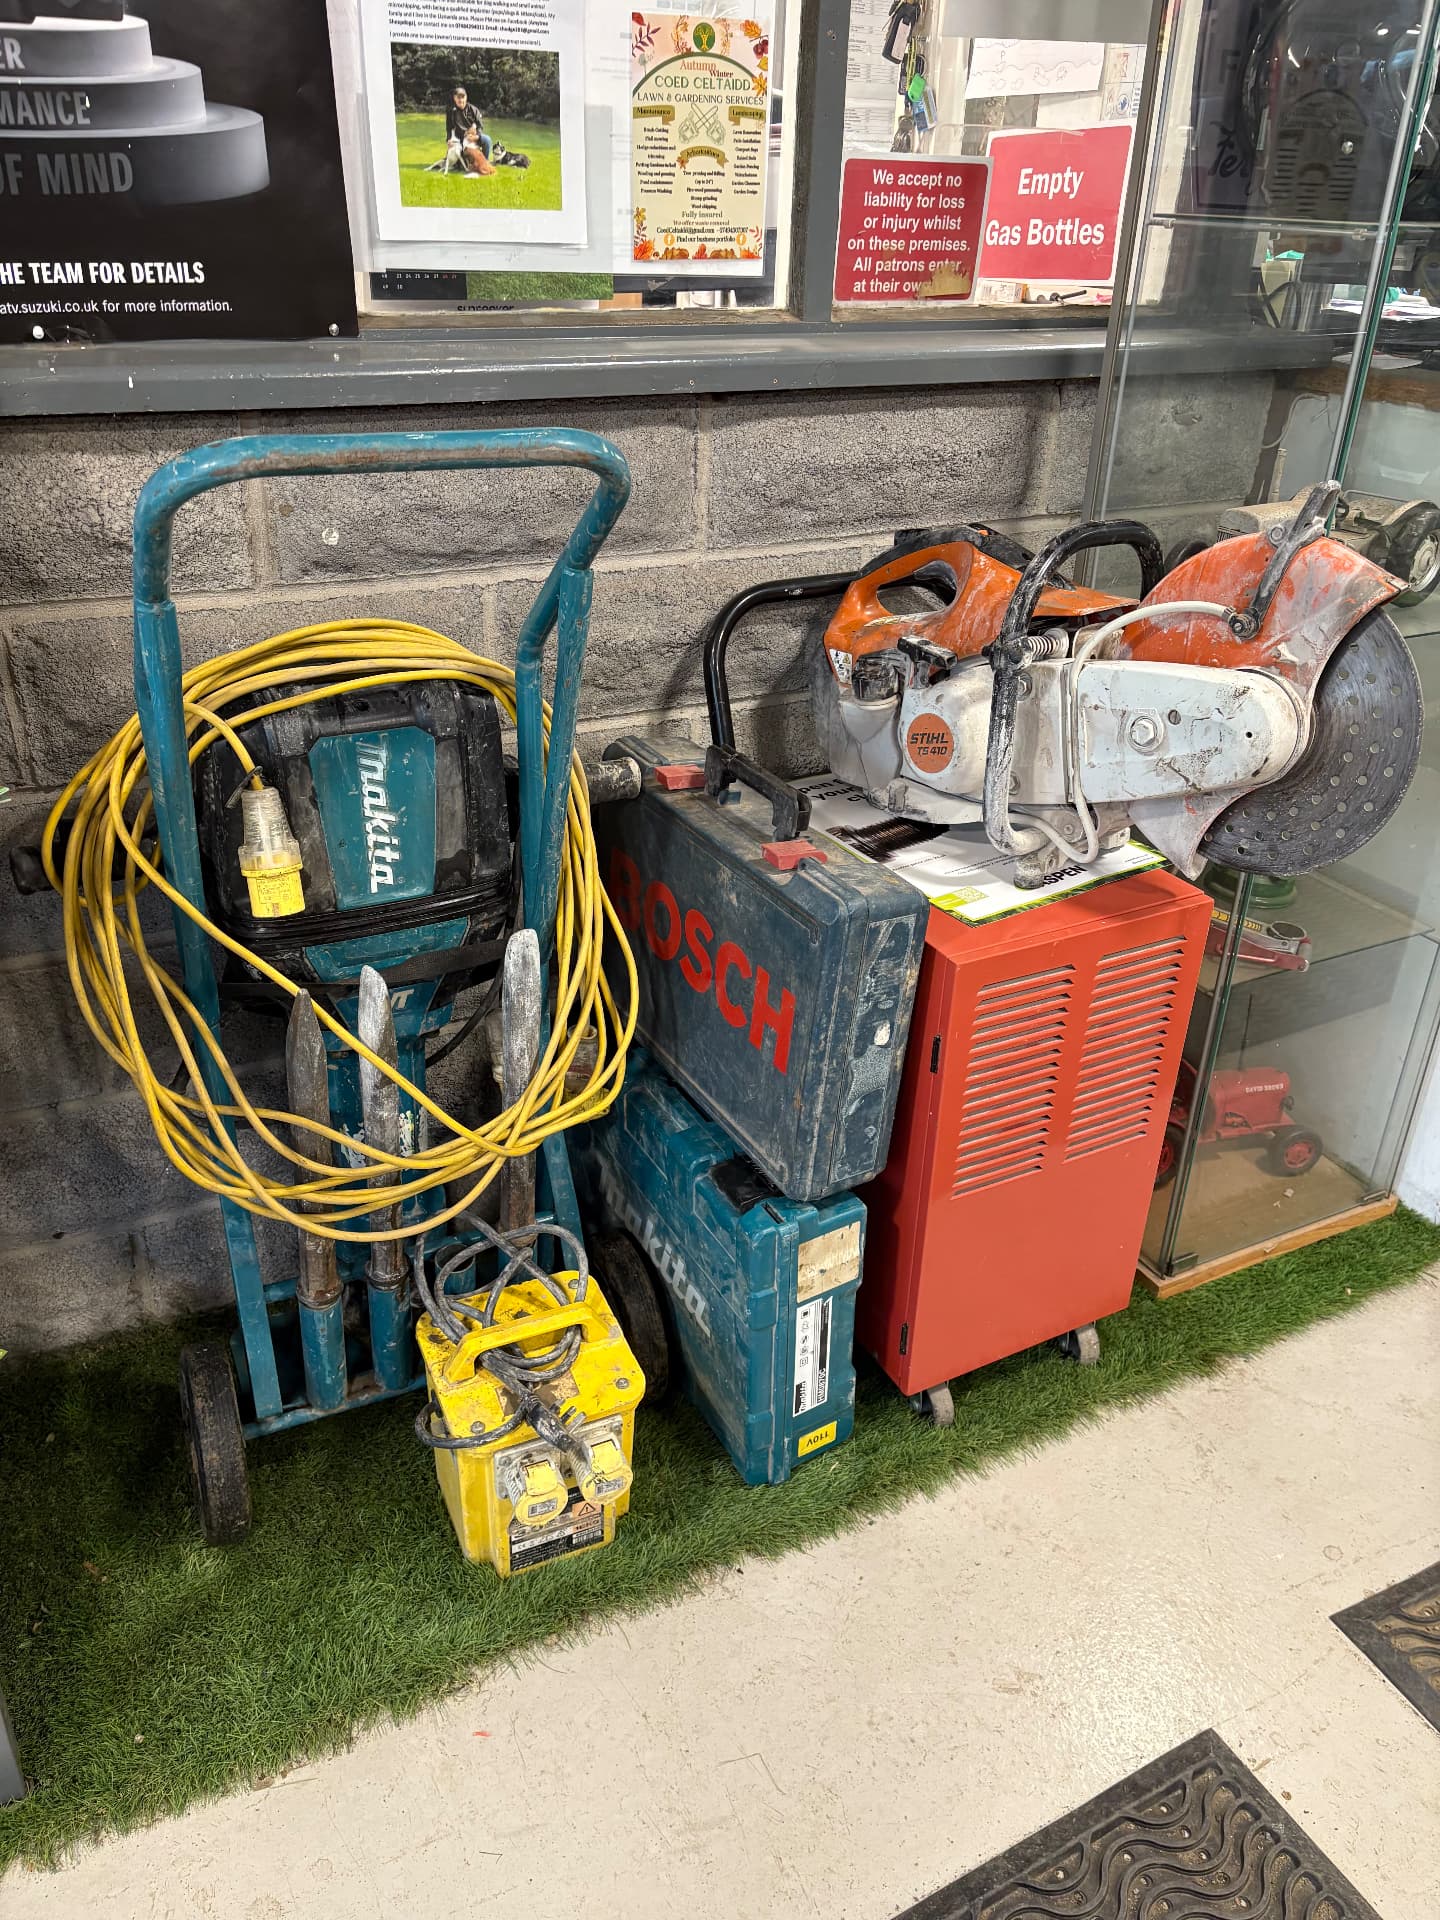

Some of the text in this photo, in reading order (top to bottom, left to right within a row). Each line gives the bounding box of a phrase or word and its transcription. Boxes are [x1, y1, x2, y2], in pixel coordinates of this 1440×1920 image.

[679, 60, 717, 72] Autumn
[708, 69, 734, 79] Winter
[654, 75, 751, 91] COED CELTAIDD
[637, 92, 664, 102] LAWN
[674, 93, 723, 104] GARDENING
[725, 95, 764, 106] SERVICES
[36, 152, 133, 195] MIND
[872, 168, 962, 190] We accept no
[1017, 166, 1084, 200] Empty
[863, 191, 965, 211] liability for loss
[863, 214, 962, 233] or injury whilst
[985, 217, 1105, 246] Gas Bottles
[847, 236, 971, 254] on these premises.
[0, 261, 205, 285] HE TEAM FOR DETAILS
[853, 257, 872, 272] All
[875, 258, 925, 275] patrons
[853, 280, 867, 293] at
[869, 278, 900, 293] their
[102, 300, 120, 313] for
[124, 302, 156, 313] more
[160, 299, 233, 312] information.
[910, 732, 949, 745] STIHL
[917, 746, 948, 756] TS 410
[355, 742, 400, 894] makita
[610, 848, 797, 1076] BOSCH
[598, 1160, 711, 1338] makita
[807, 1431, 828, 1447] 110V
